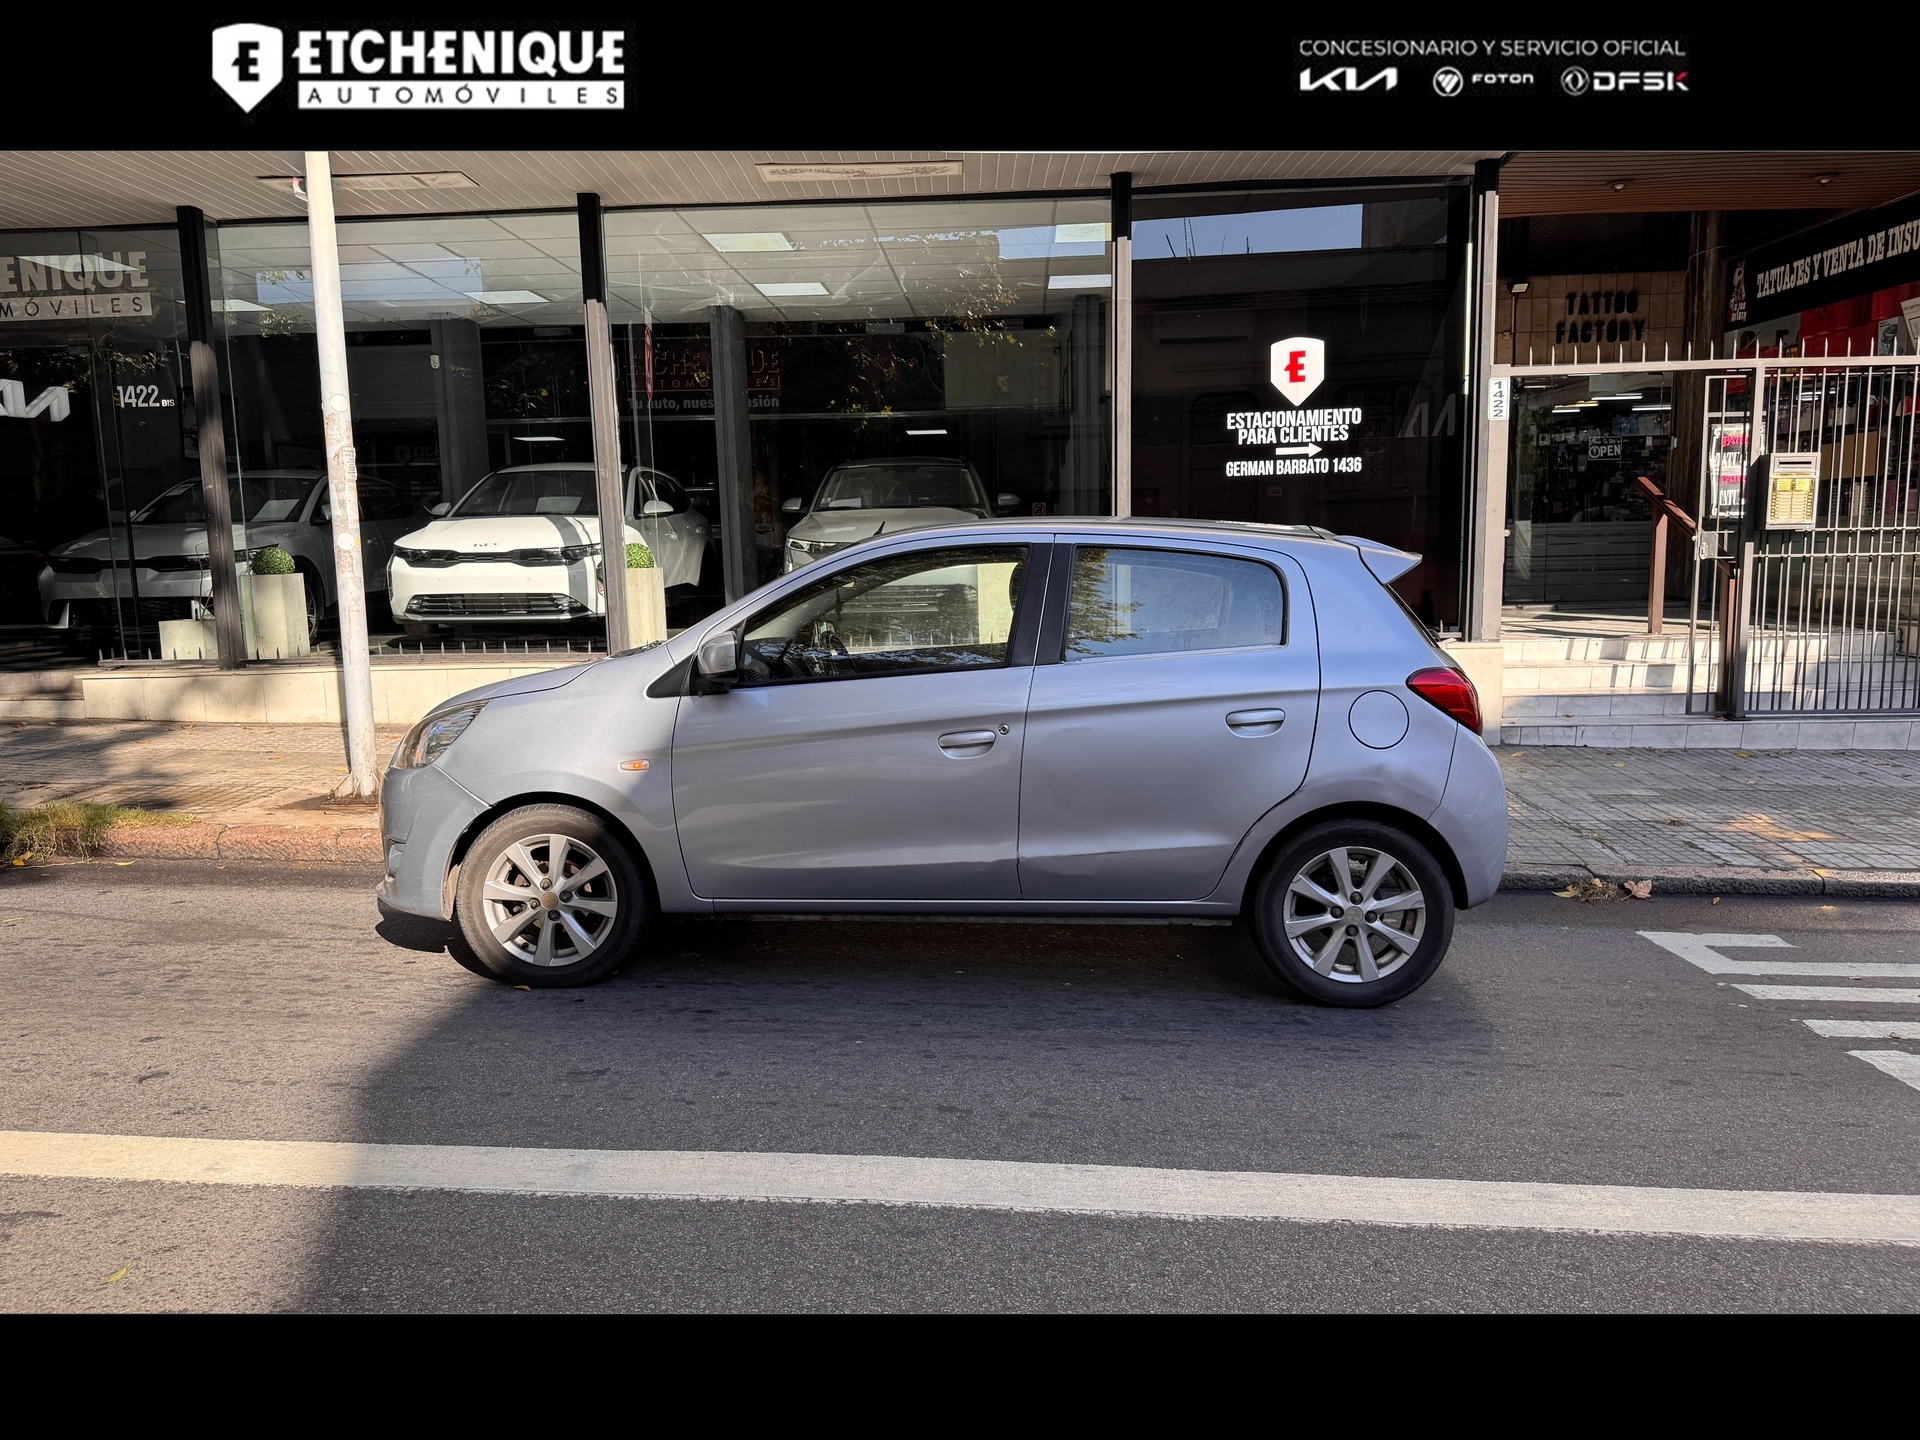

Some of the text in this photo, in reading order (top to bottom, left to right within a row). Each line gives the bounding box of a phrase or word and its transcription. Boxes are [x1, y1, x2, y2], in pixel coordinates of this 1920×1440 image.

[1757, 256, 1811, 299] TATUAJES
[1813, 253, 1822, 281] Y
[1823, 238, 1864, 277] VENTA
[1867, 231, 1886, 264] DE
[1566, 291, 1637, 315] TATTOO
[1556, 320, 1646, 344] FACTORY
[1284, 350, 1306, 383] E
[116, 384, 161, 408] 1422
[1492, 381, 1505, 418] 1422
[1227, 408, 1362, 430] ESTACIONAMIENTO
[1238, 424, 1349, 445] PARA CLIENTES
[1588, 444, 1621, 459] OPEN
[1226, 457, 1362, 477] GERMAN BARBATO 1436
